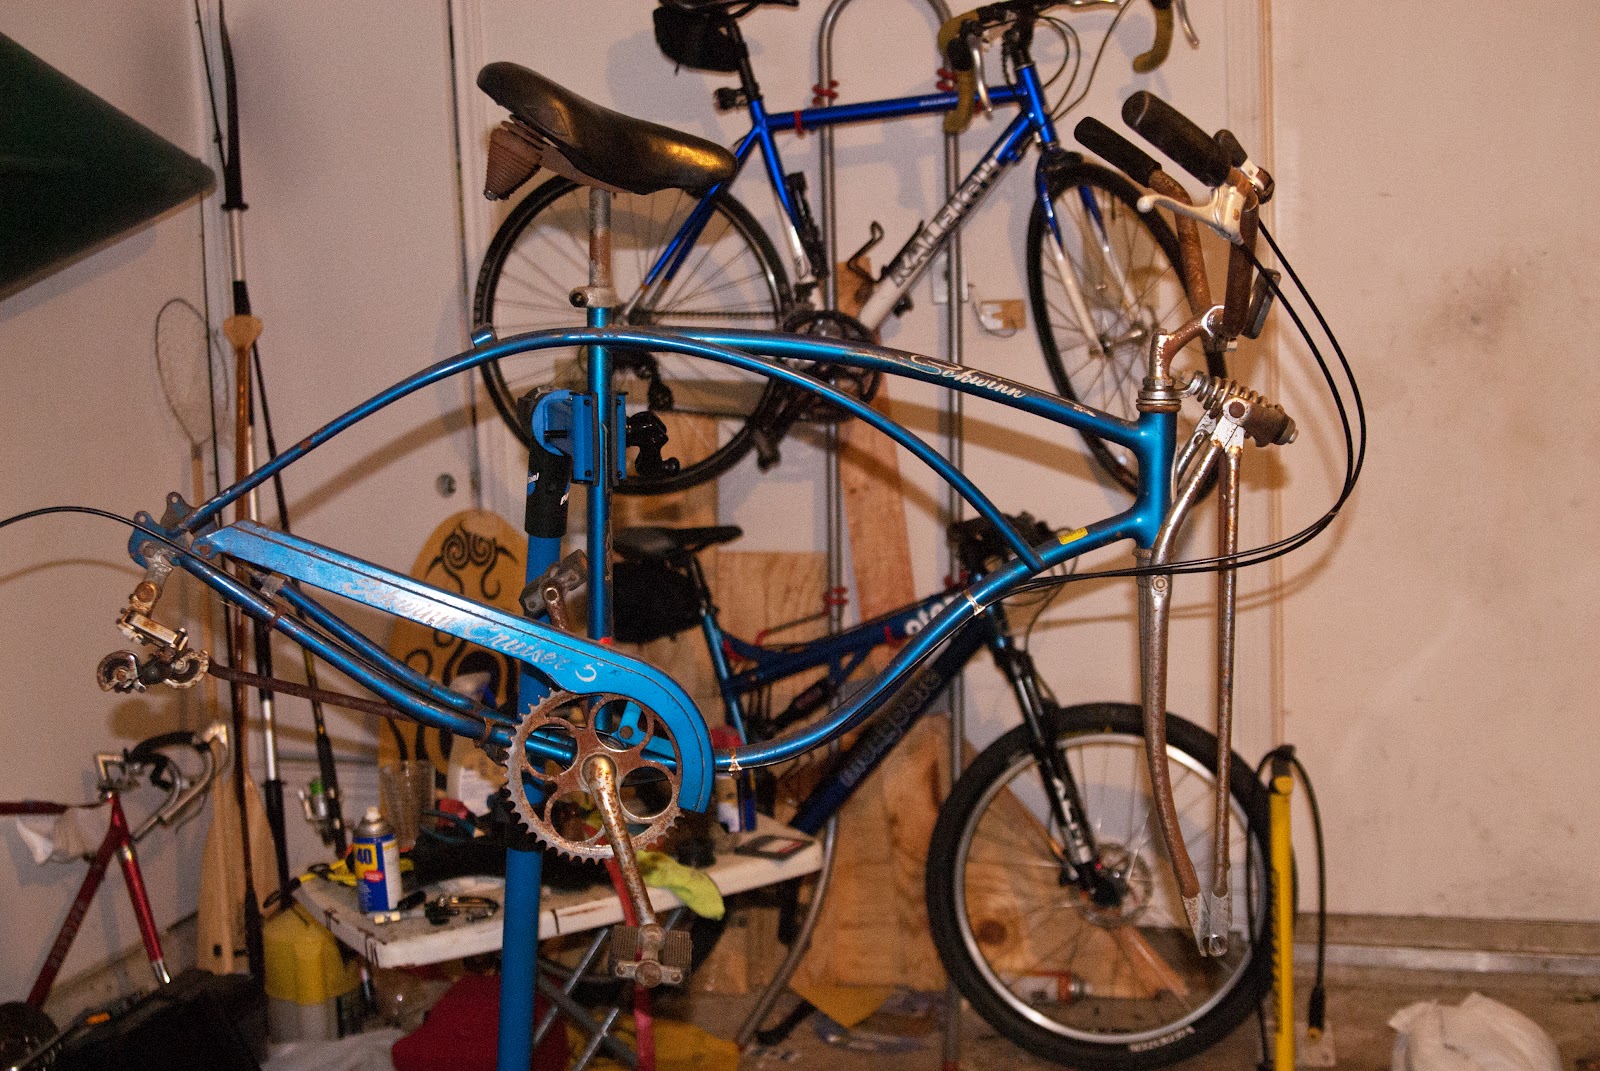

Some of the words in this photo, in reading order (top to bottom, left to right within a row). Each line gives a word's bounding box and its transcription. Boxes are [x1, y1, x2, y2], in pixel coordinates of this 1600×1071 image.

[900, 354, 1027, 399] Schwinn
[344, 577, 458, 629] Schwinn
[464, 621, 571, 671] Cruiser
[574, 661, 604, 683] 5
